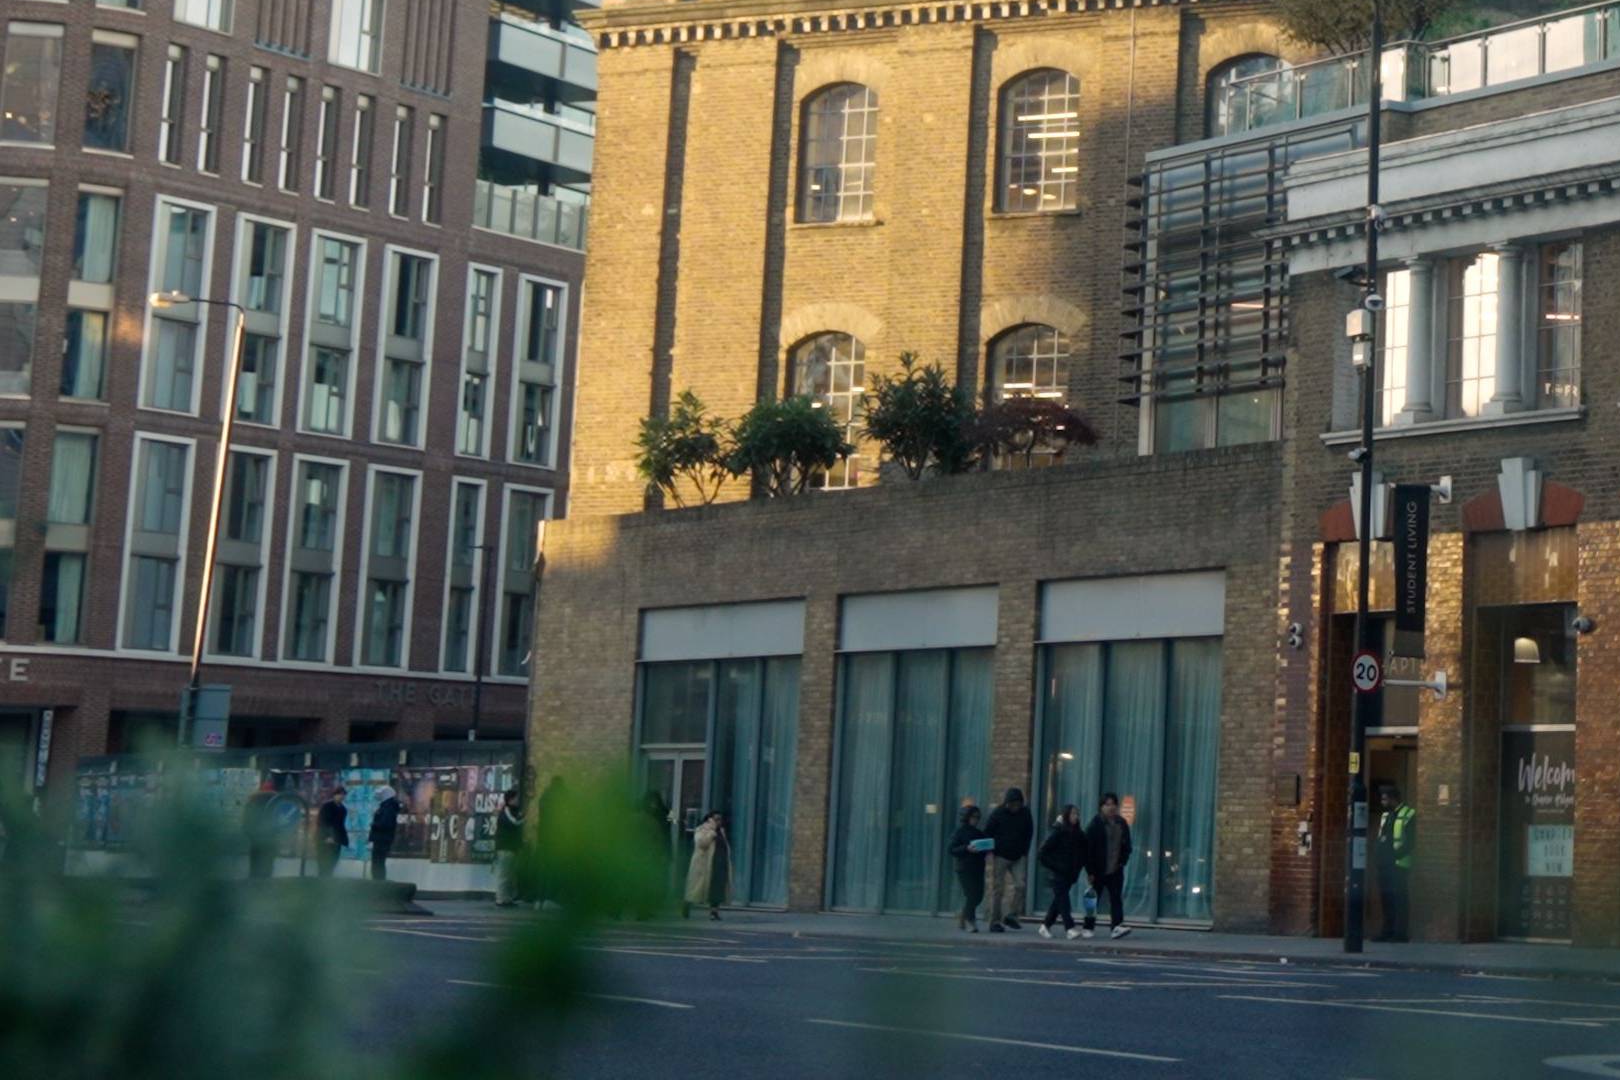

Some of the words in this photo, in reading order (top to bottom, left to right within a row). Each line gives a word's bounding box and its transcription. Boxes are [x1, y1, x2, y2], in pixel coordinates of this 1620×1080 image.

[1406, 500, 1417, 549] LIVING
[1406, 552, 1417, 615] STUDENT
[1355, 663, 1377, 682] 20
[375, 680, 416, 704] THE
